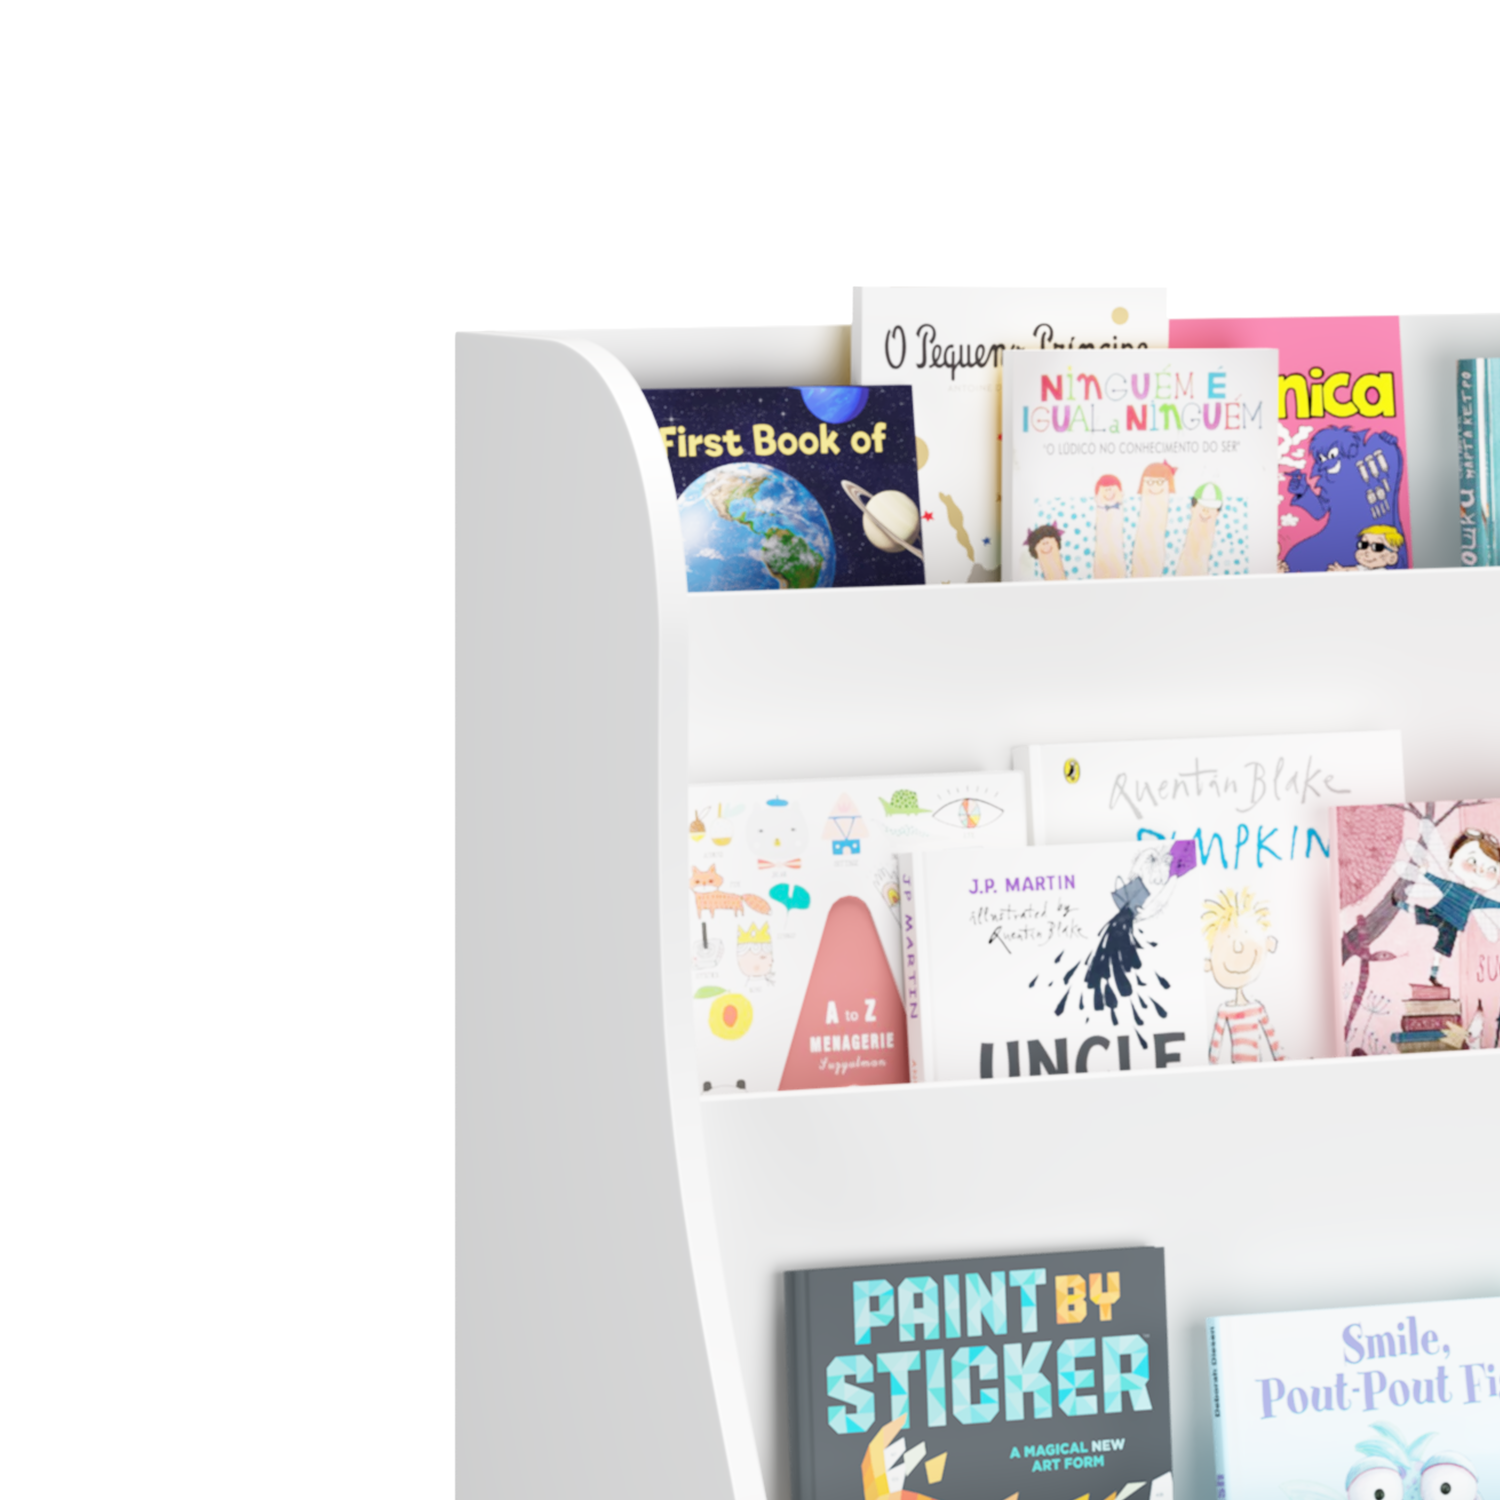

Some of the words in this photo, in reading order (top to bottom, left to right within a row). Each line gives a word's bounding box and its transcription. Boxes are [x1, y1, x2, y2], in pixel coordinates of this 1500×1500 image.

[885, 325, 906, 369] O
[916, 324, 1025, 381] Pequen
[1208, 365, 1227, 400] É
[1278, 366, 1397, 420] nica
[1022, 403, 1107, 433] IGUAL
[659, 425, 744, 458] First
[752, 423, 841, 456] Book
[851, 422, 887, 454] of
[1100, 442, 1116, 454] NO
[1119, 441, 1199, 454] CONHECIMENTO
[1202, 440, 1218, 453] DO
[1460, 489, 1478, 567] ОШКИ
[1109, 757, 1238, 820] Quentin
[1235, 755, 1351, 813] Blake
[1137, 824, 1330, 869] MPKIN
[969, 878, 997, 894] J.P.
[1005, 874, 1075, 892] MARTIN
[969, 901, 1048, 925] illustrated
[1057, 897, 1079, 917] by
[988, 924, 1041, 954] Quentin
[1038, 919, 1088, 947] Blake
[905, 914, 918, 1019] MARTIN
[825, 1000, 839, 1025] A
[845, 1010, 859, 1022] to
[864, 998, 877, 1022] Z
[809, 1032, 895, 1053] MENAGERIE
[852, 1267, 1047, 1345] PAINT
[1054, 1271, 1121, 1324] BY
[1342, 1316, 1451, 1366] Smile,
[825, 1333, 1153, 1435] STICKER
[1255, 1365, 1453, 1419] Pout-Pout
[1009, 1446, 1021, 1459] A
[1024, 1441, 1089, 1458] MAGICAL
[1091, 1438, 1125, 1453] NEW
[1031, 1458, 1061, 1473] ART
[1064, 1454, 1105, 1470] FORM
